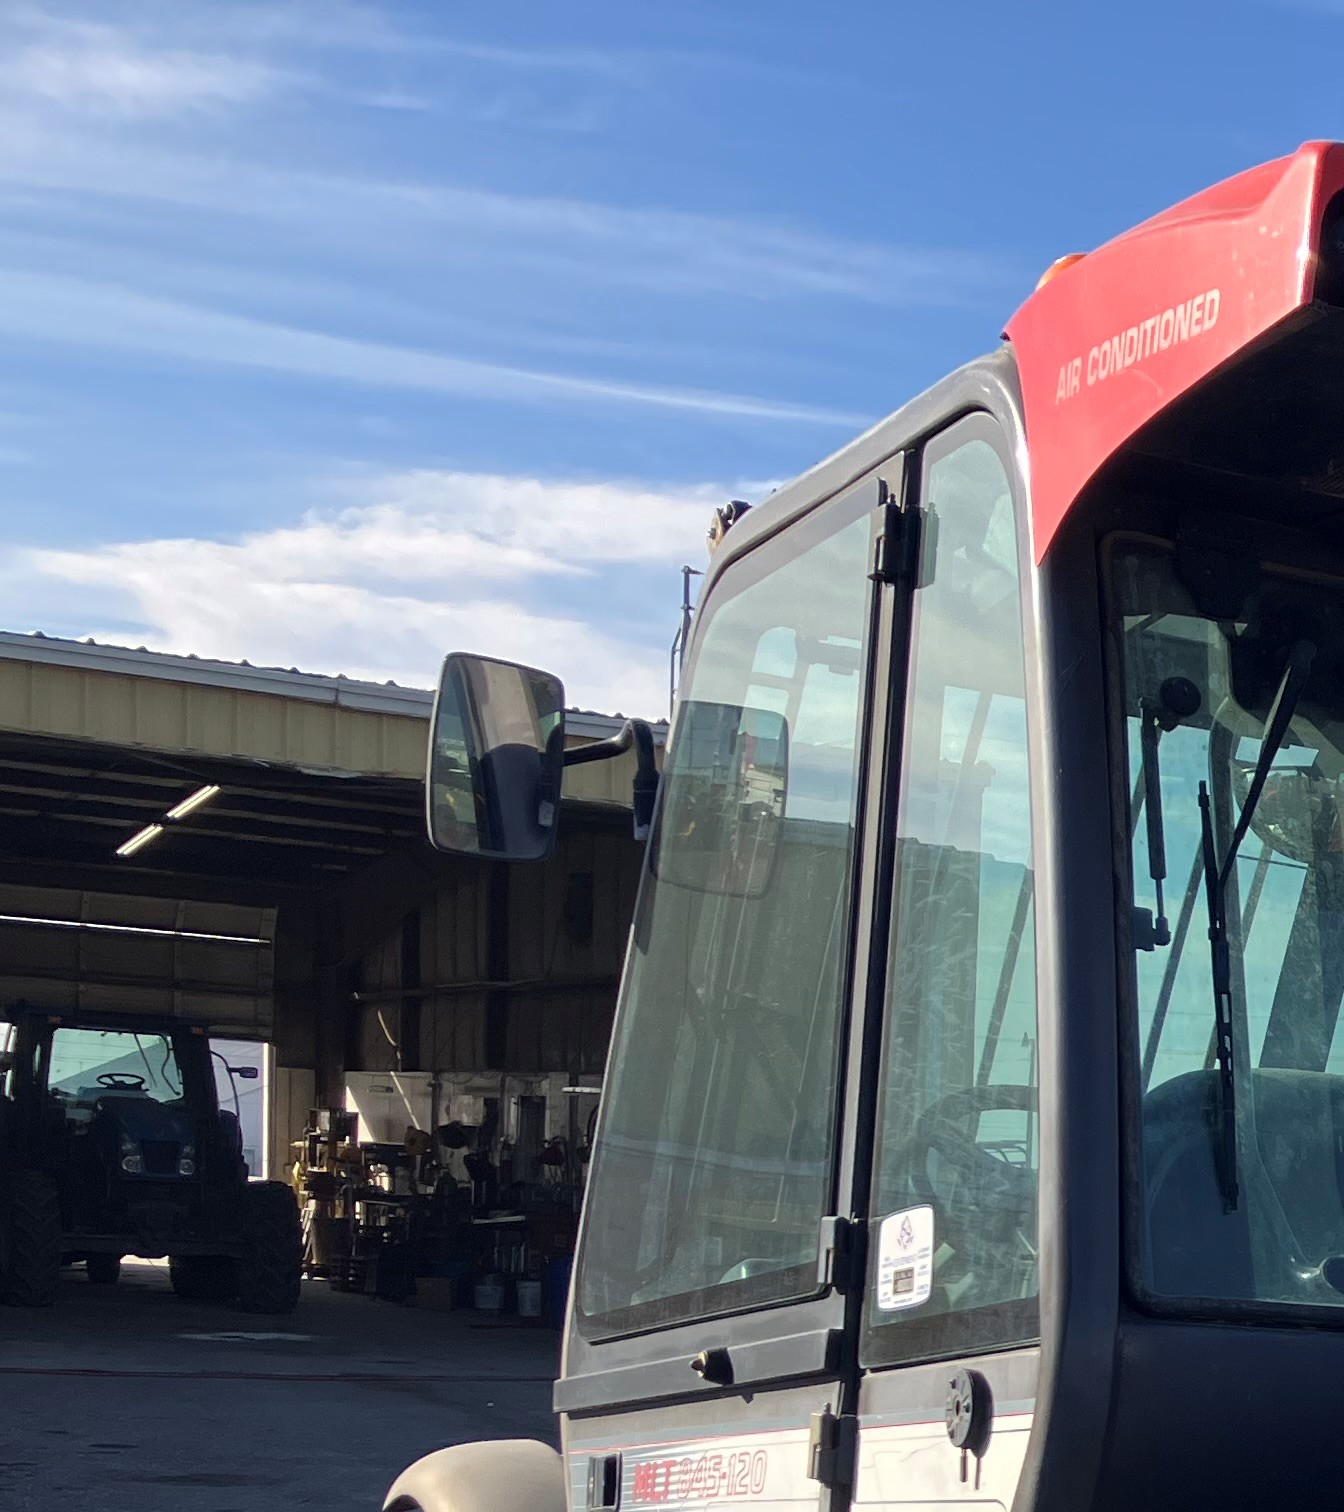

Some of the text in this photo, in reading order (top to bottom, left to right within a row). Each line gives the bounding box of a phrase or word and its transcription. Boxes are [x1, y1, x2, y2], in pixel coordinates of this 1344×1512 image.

[1055, 287, 1221, 405] AIR CONDITIONED
[632, 1459, 678, 1504] MLT
